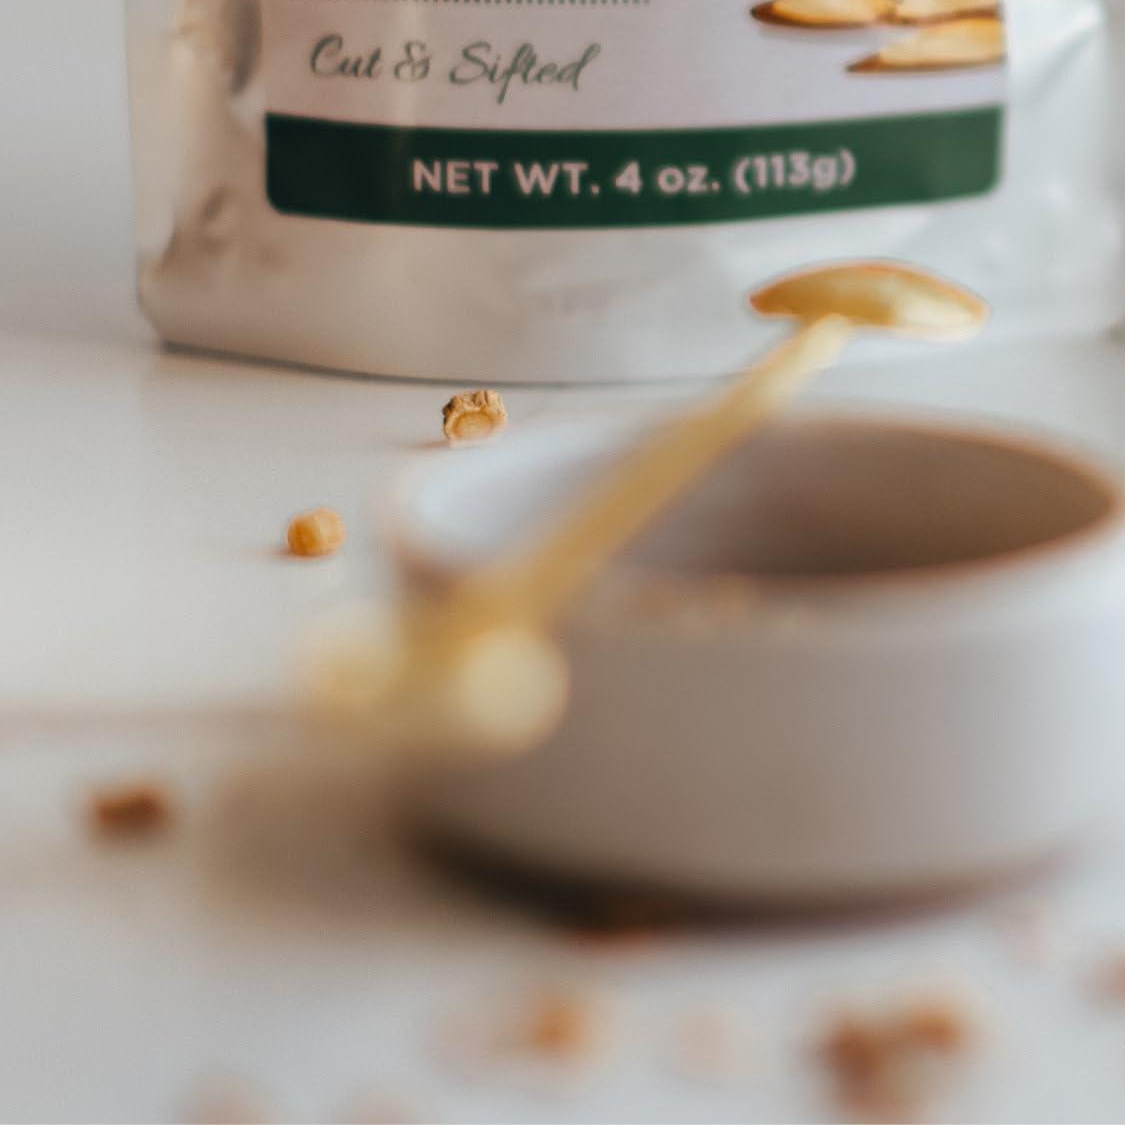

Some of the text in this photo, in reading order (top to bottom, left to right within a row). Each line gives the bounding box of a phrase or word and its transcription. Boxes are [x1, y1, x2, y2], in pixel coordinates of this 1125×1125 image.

[310, 34, 601, 105] Cut & Sifted
[412, 149, 856, 196] NET WT. 4 oz. (113g)
